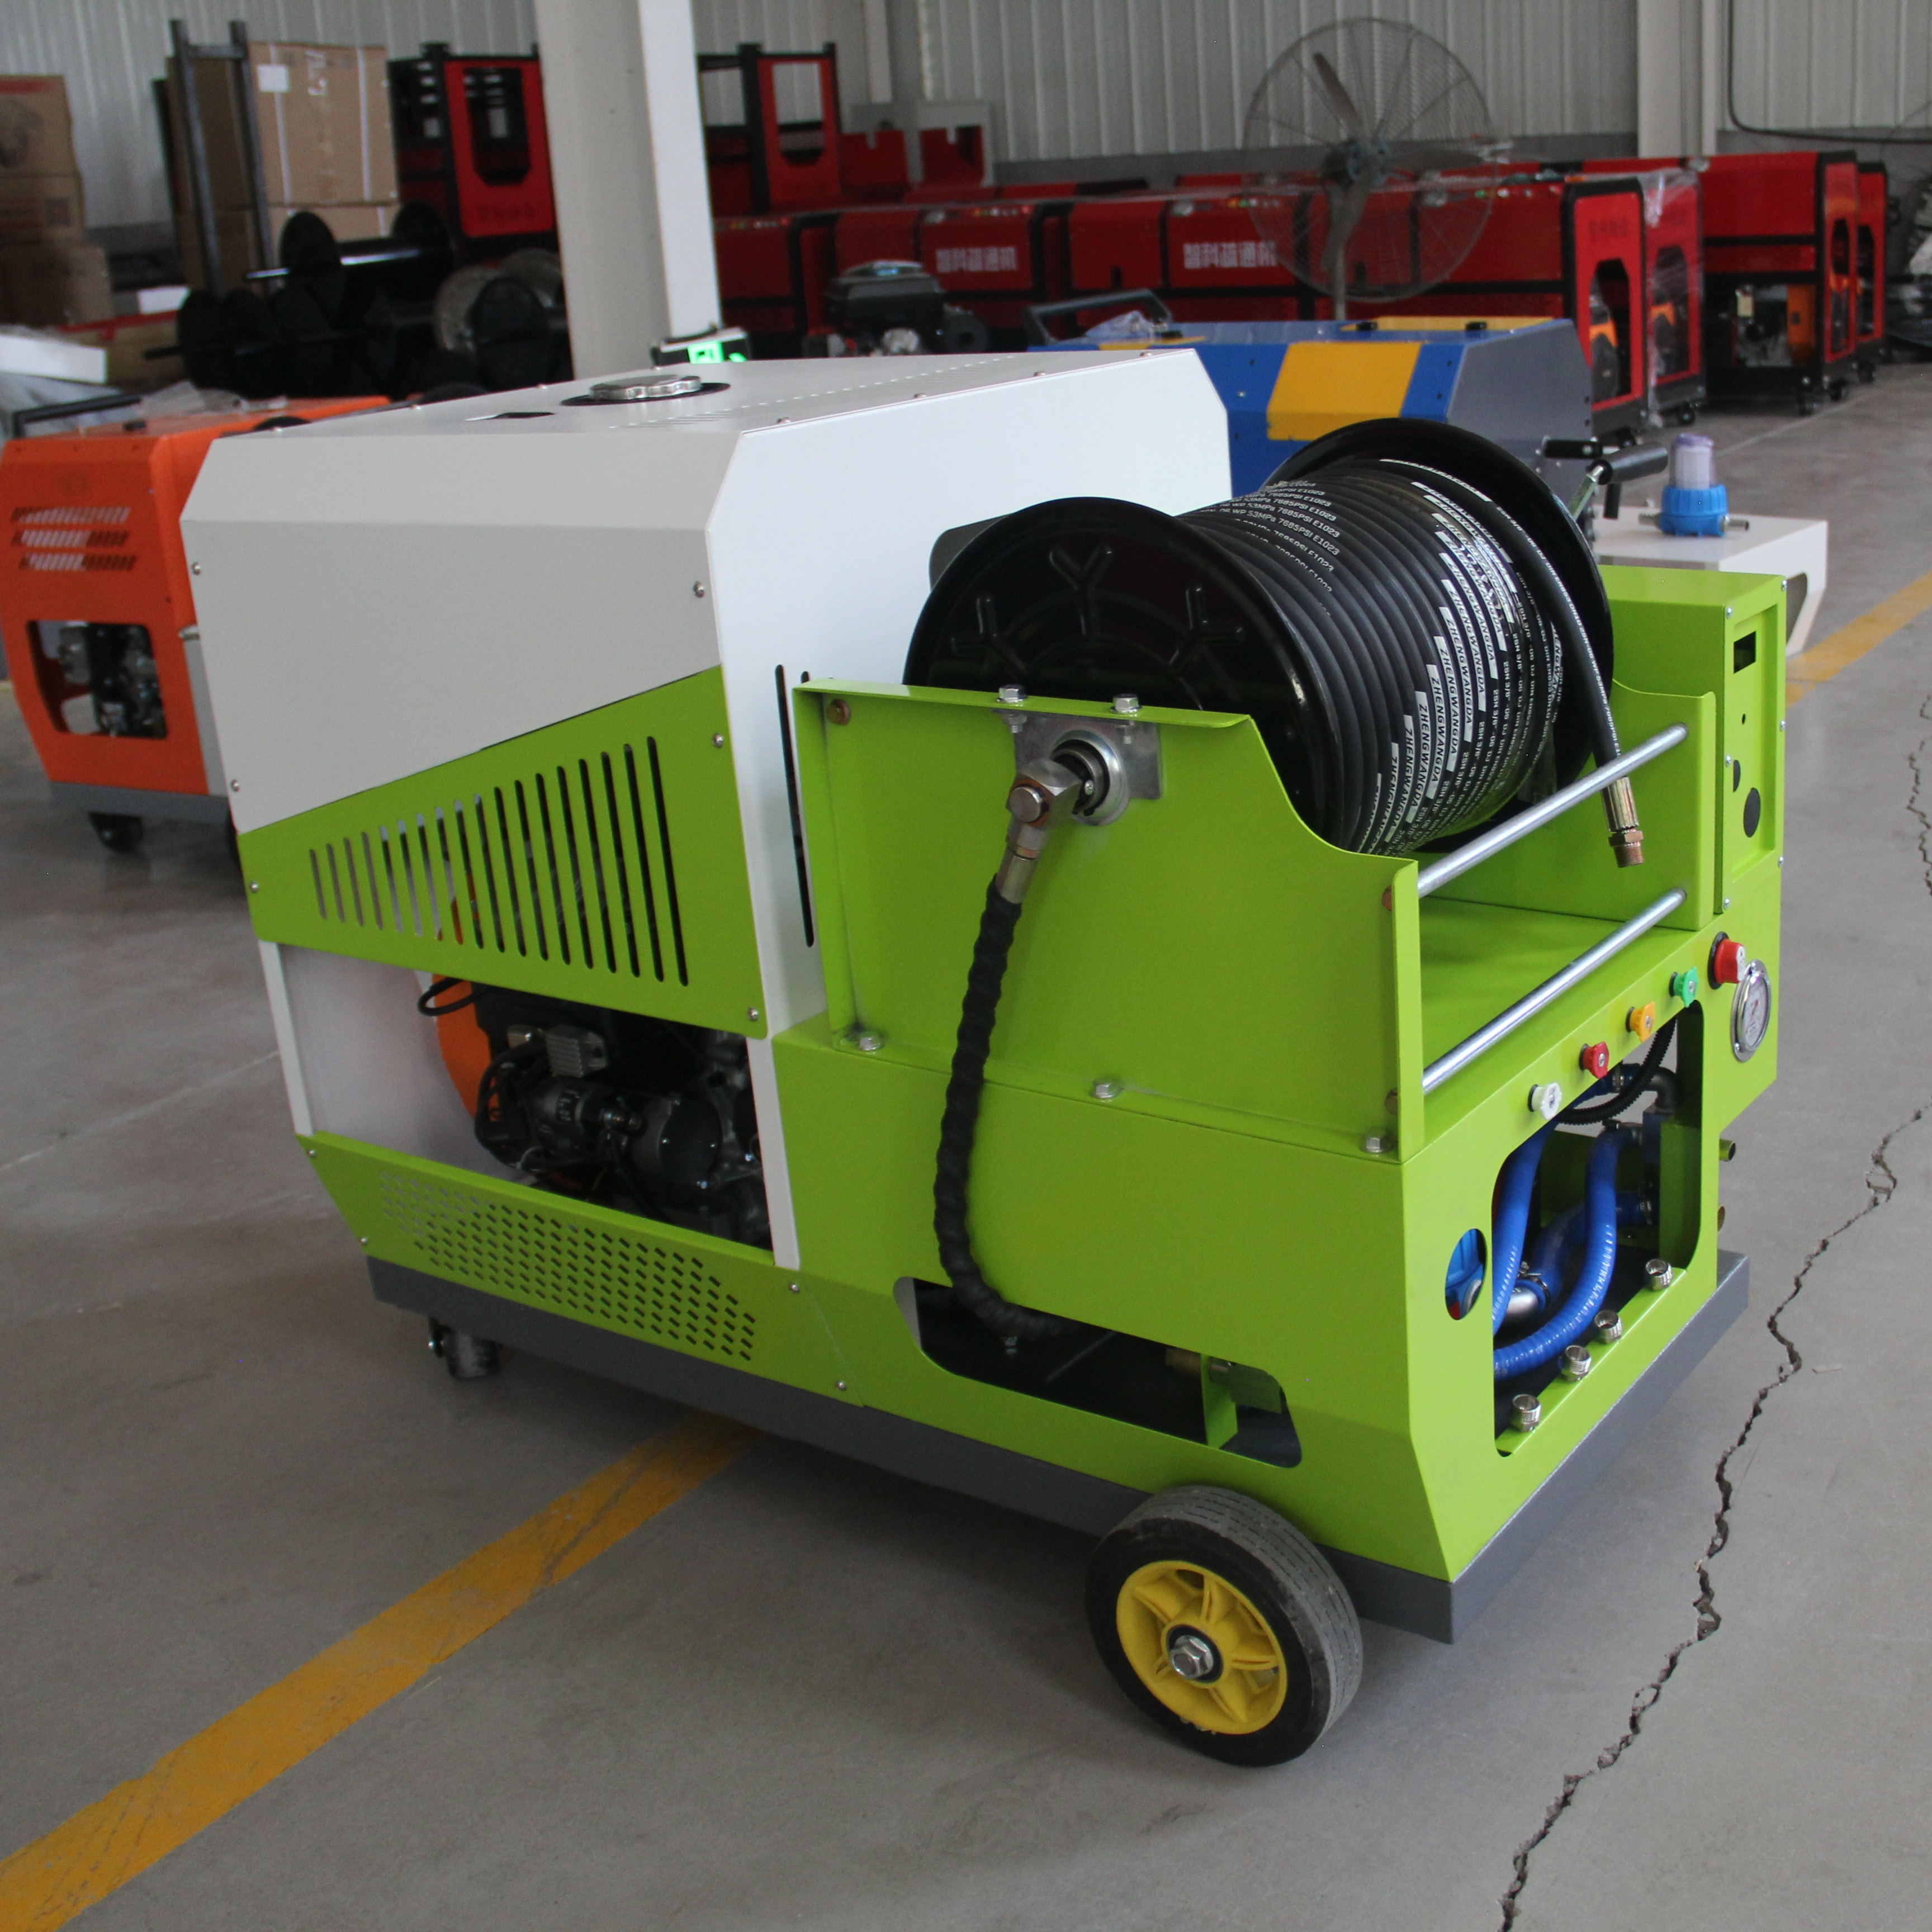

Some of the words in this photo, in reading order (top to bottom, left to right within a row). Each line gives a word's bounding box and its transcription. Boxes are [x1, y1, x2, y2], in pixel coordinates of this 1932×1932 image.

[1247, 501, 1276, 512] 53MPa
[1277, 506, 1313, 524] 7685PSI
[1311, 519, 1341, 539] E1023
[1247, 509, 1277, 523] 53MPa
[1277, 517, 1314, 539] 7685PSI
[1311, 534, 1341, 557] E1023
[1268, 491, 1304, 501] 7685PSI
[1303, 495, 1333, 508] E1023
[1273, 498, 1309, 512] 7685PSI
[1308, 506, 1338, 523] E1023
[1297, 487, 1326, 498] E1023
[1435, 498, 1508, 577] ZHENGW
[1446, 560, 1497, 661] ZHENGWANGDA
[1545, 561, 1557, 576] DIN
[1568, 602, 1583, 626] DN10
[1590, 660, 1600, 675] WP
[1437, 646, 1461, 756] ZHENGWANGDA
[1444, 616, 1473, 725] ZHENGWANGDA
[1459, 750, 1469, 771] 2SN
[1447, 588, 1488, 694] ZHENGWANGDA
[1476, 721, 1485, 741] 2SN
[1502, 660, 1510, 680] 2SN
[1389, 727, 1414, 829] ZHENGWANGDA
[1409, 702, 1432, 810] ZHENGWANGDA
[1427, 675, 1448, 784] ZHENGWANGDA
